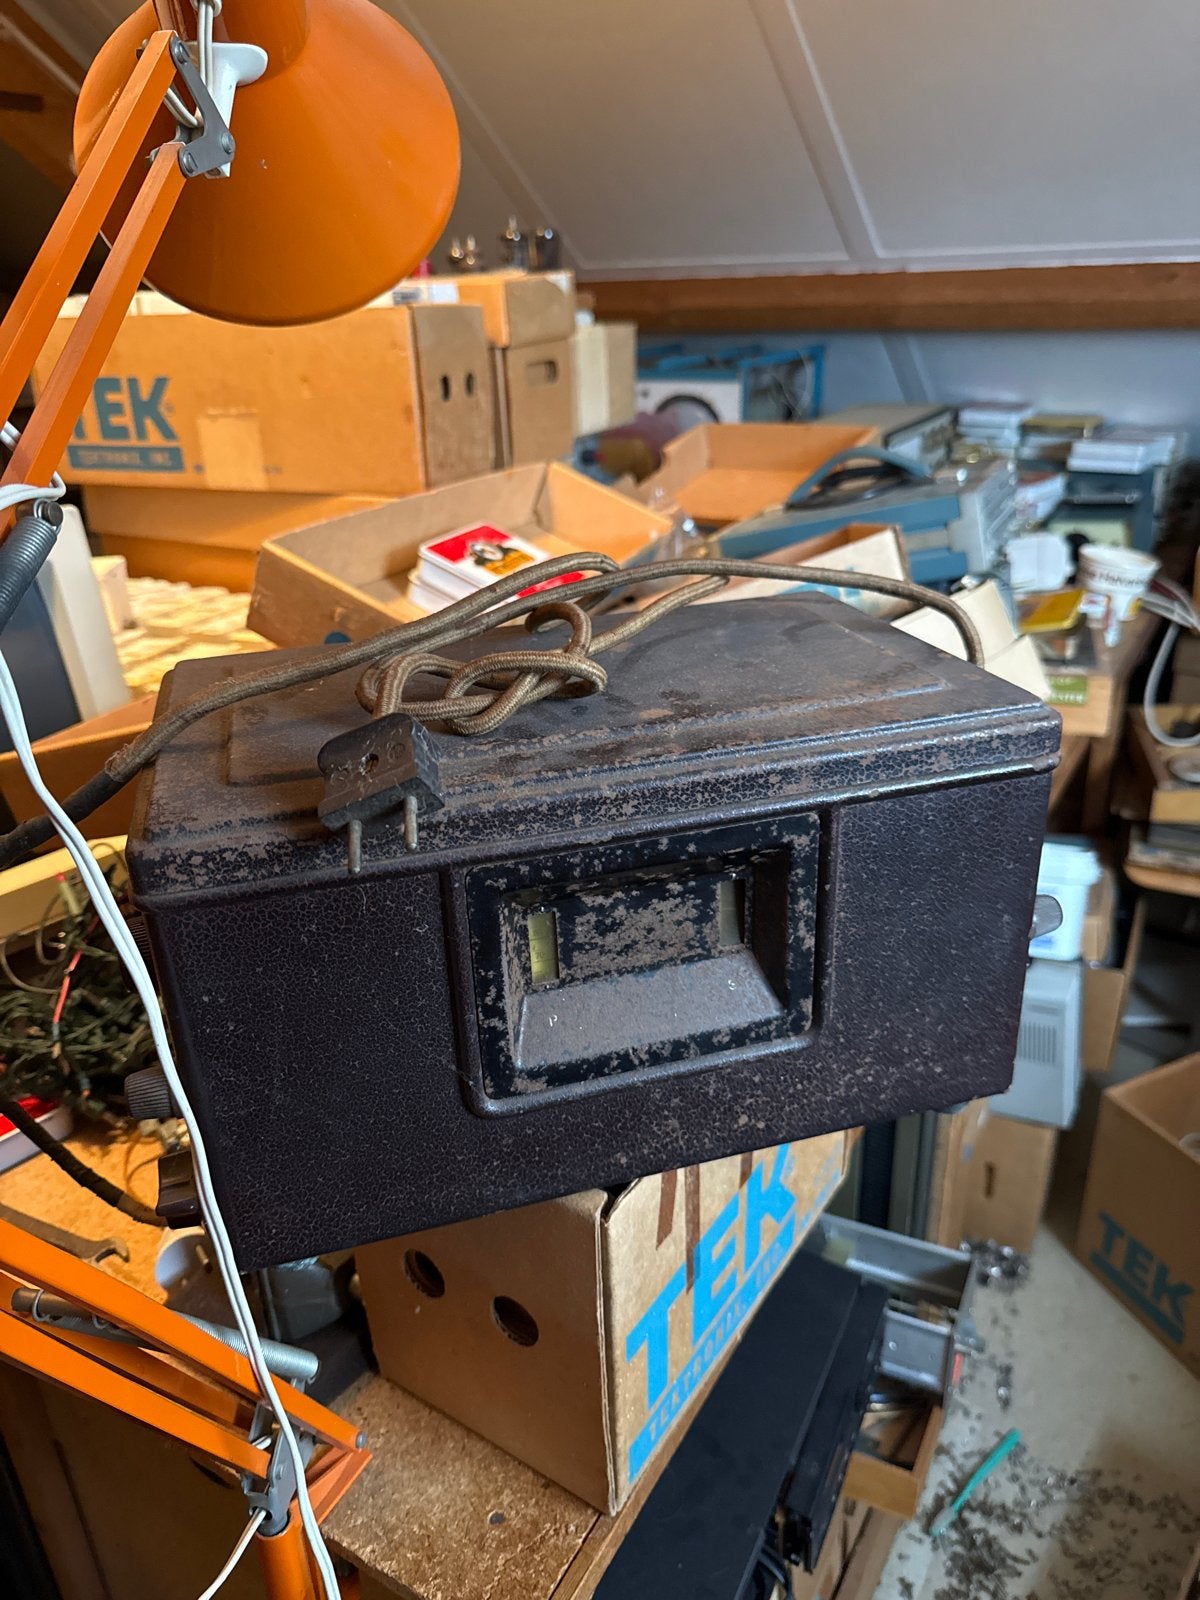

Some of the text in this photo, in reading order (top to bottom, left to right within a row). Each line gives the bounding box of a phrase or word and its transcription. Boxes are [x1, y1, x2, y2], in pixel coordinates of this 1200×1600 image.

[74, 377, 178, 440] EK
[626, 1143, 797, 1412] TEK
[1098, 1210, 1194, 1325] TEK
